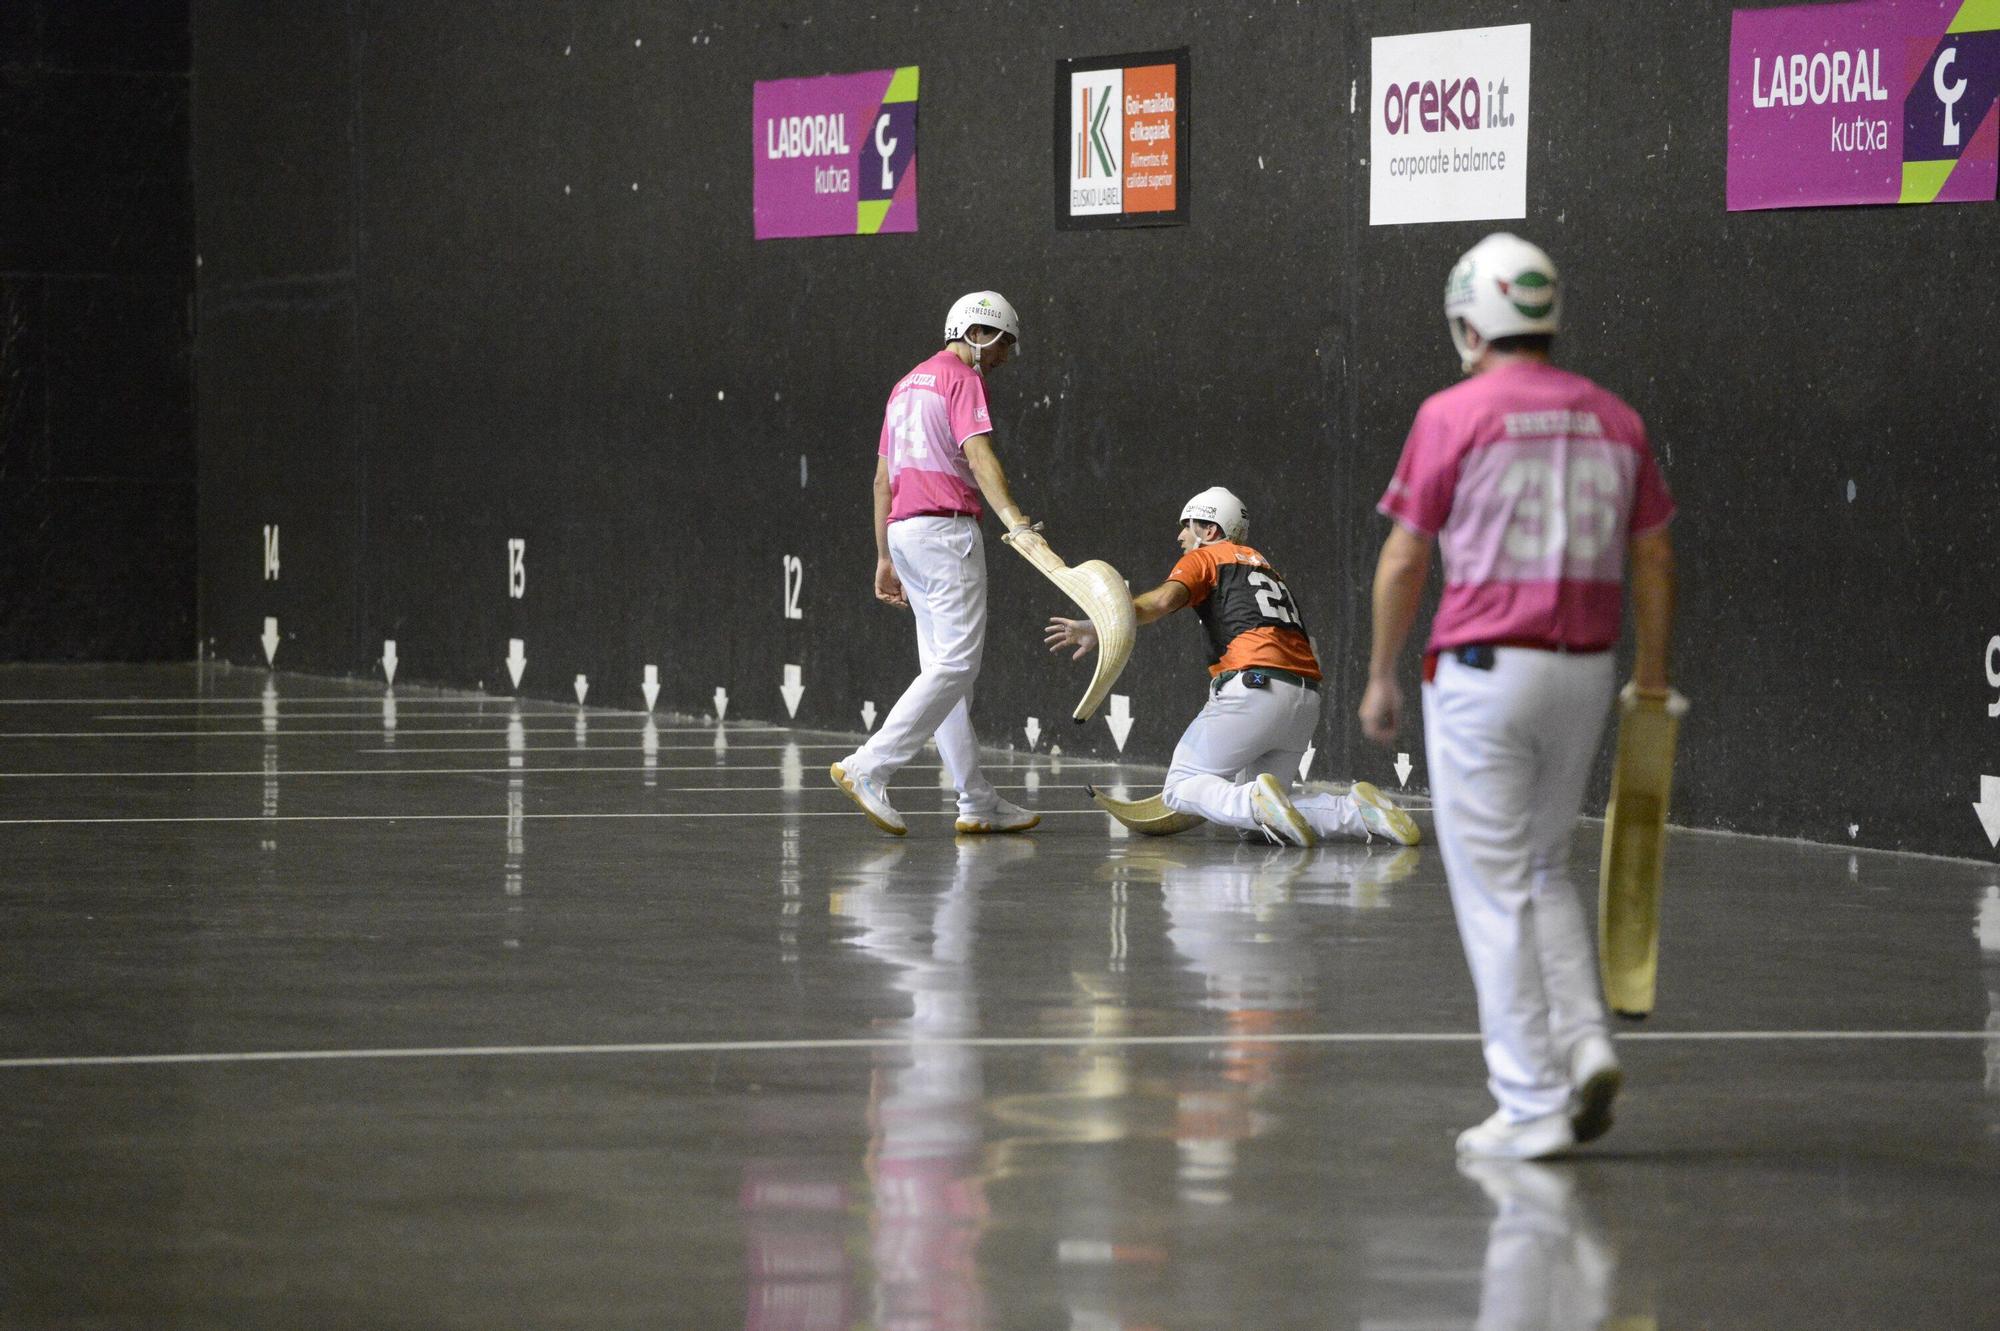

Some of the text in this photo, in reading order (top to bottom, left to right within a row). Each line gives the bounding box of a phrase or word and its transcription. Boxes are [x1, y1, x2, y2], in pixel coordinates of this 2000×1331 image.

[1753, 48, 1888, 109] LABORAL
[1126, 92, 1175, 115] Goi-mailako
[1384, 76, 1480, 134] oreka
[767, 112, 850, 159] LABORAL
[1130, 119, 1170, 146] elikagaiak
[1831, 117, 1888, 152] kutxa
[1130, 151, 1168, 168] Alimentos de
[1390, 147, 1506, 180] corporate balance
[814, 165, 850, 195] kutxa
[1127, 171, 1173, 190] calidad superior
[1072, 187, 1120, 207] EUSKO LABEL
[947, 327, 958, 339] 34
[263, 524, 280, 581] 14
[508, 538, 526, 599] 13
[784, 554, 803, 620] 12
